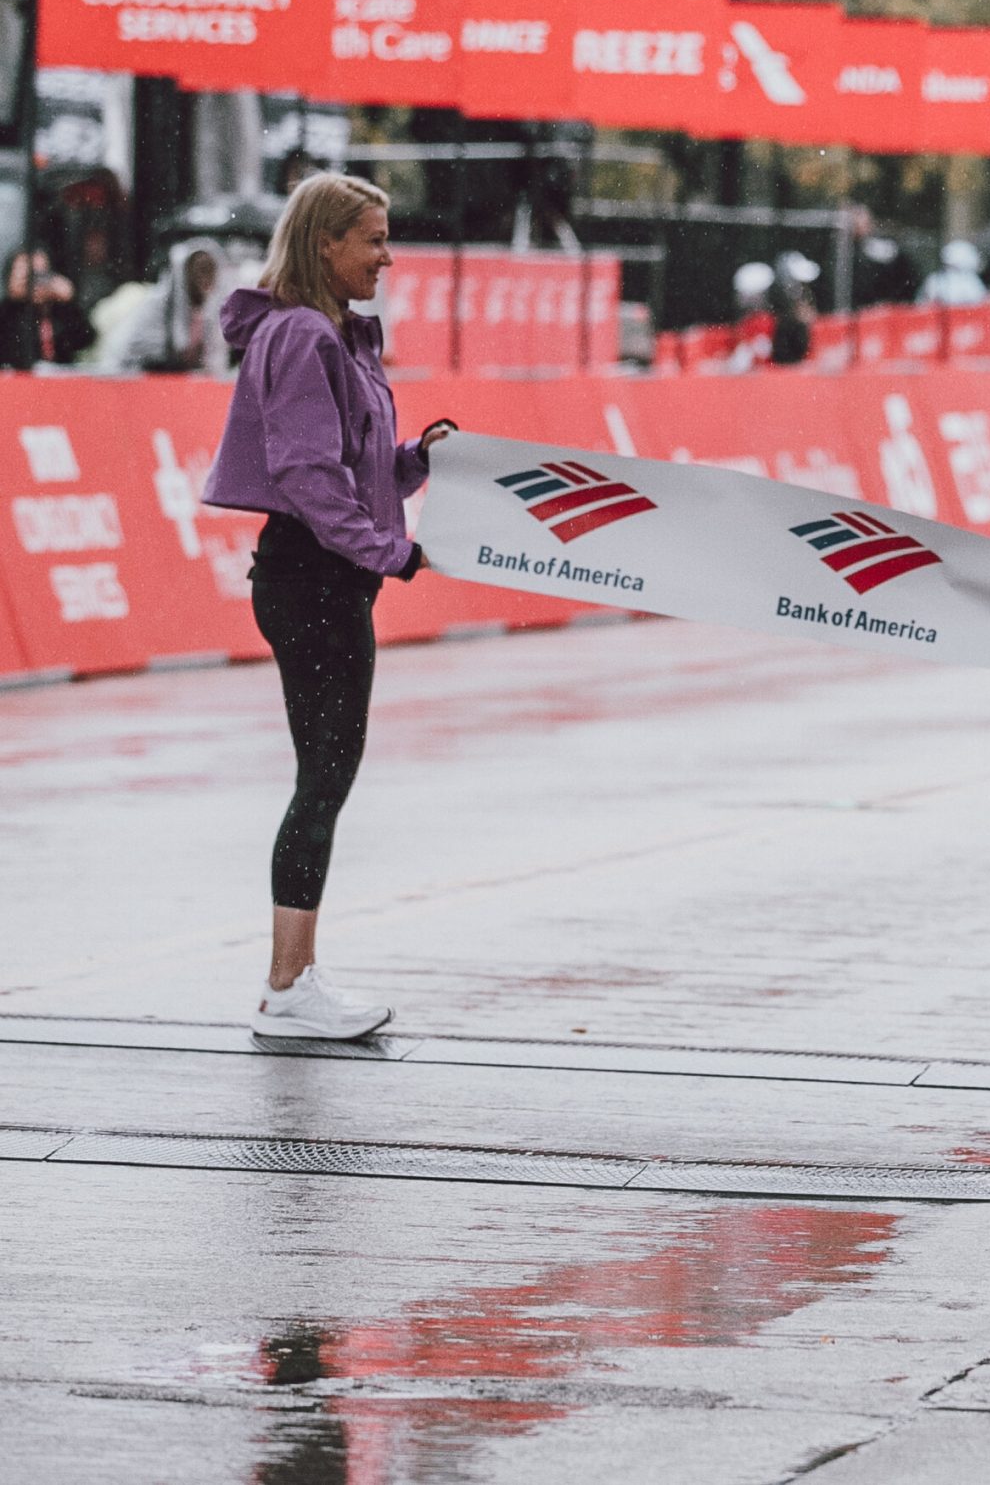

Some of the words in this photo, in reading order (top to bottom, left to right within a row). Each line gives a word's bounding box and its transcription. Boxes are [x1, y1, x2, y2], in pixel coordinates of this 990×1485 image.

[116, 7, 258, 45] SERVICES
[477, 545, 529, 572] Bank
[533, 557, 556, 576] of
[556, 559, 645, 592] America
[776, 596, 829, 624] Bank
[831, 608, 854, 628] of
[854, 611, 938, 643] America
